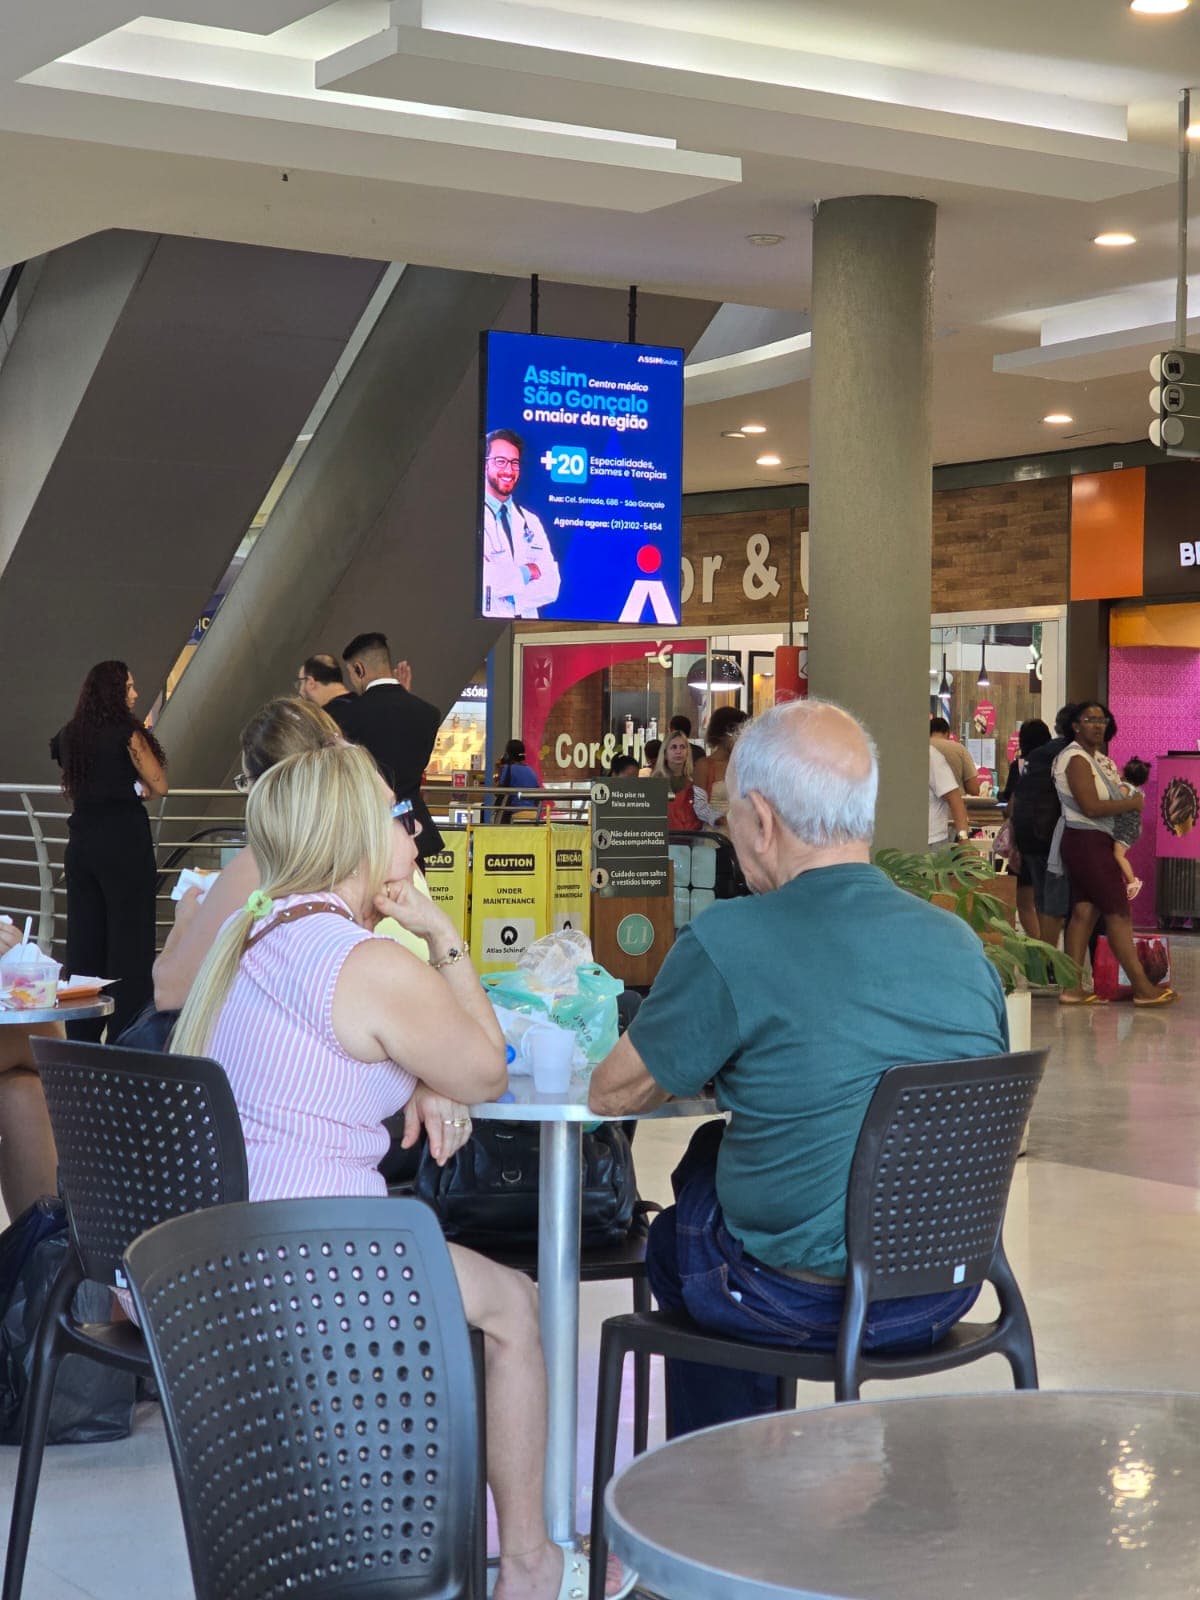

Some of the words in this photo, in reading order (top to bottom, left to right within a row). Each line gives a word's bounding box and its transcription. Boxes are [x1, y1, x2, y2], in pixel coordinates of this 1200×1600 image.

[638, 355, 663, 364] ASSIM
[523, 365, 587, 387] Assim
[588, 379, 616, 390] Centro
[617, 381, 649, 392] médico
[523, 386, 562, 406] São
[565, 390, 648, 416] Gonçalo
[523, 409, 533, 421] o
[535, 408, 579, 424] maior
[580, 412, 600, 426] da
[602, 414, 648, 431] região
[540, 451, 585, 476] +20
[590, 456, 654, 470] Especialidades,
[590, 467, 622, 476] Exames
[632, 470, 667, 480] Terapias
[554, 518, 584, 527] Agende
[585, 520, 610, 529] agora:
[743, 533, 780, 600] &
[640, 830, 664, 838] crianças
[487, 858, 533, 867] CAUTION
[641, 878, 661, 886] longos
